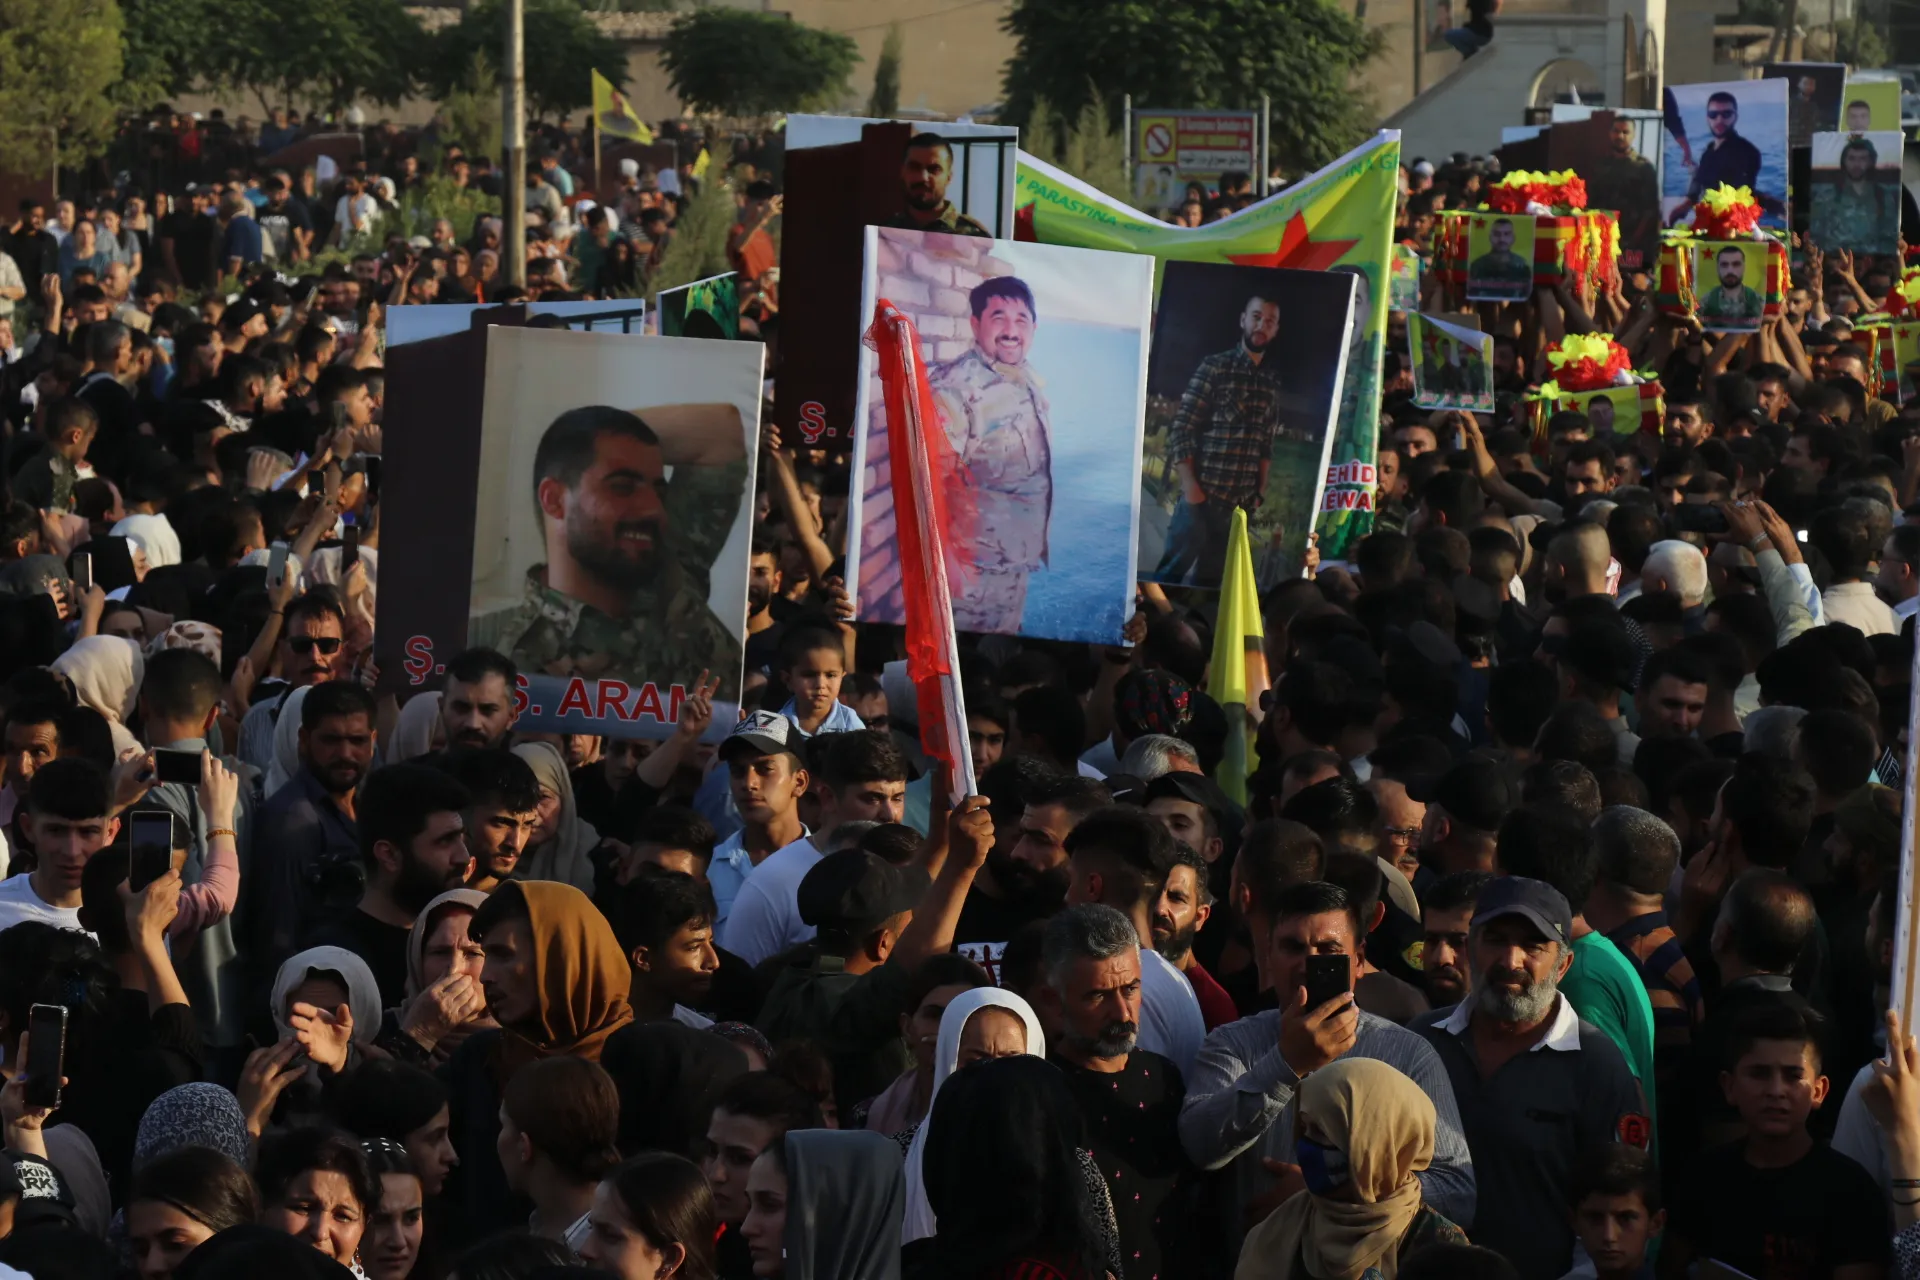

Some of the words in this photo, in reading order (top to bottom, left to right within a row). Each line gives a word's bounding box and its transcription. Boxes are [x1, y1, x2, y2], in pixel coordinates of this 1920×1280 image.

[1026, 179, 1117, 226] PARASTINA
[799, 401, 837, 444] Ş.
[1326, 459, 1375, 484] EHÎD
[1320, 489, 1372, 510] ÊWA
[402, 634, 446, 686] Ş.
[732, 712, 778, 734] EA7
